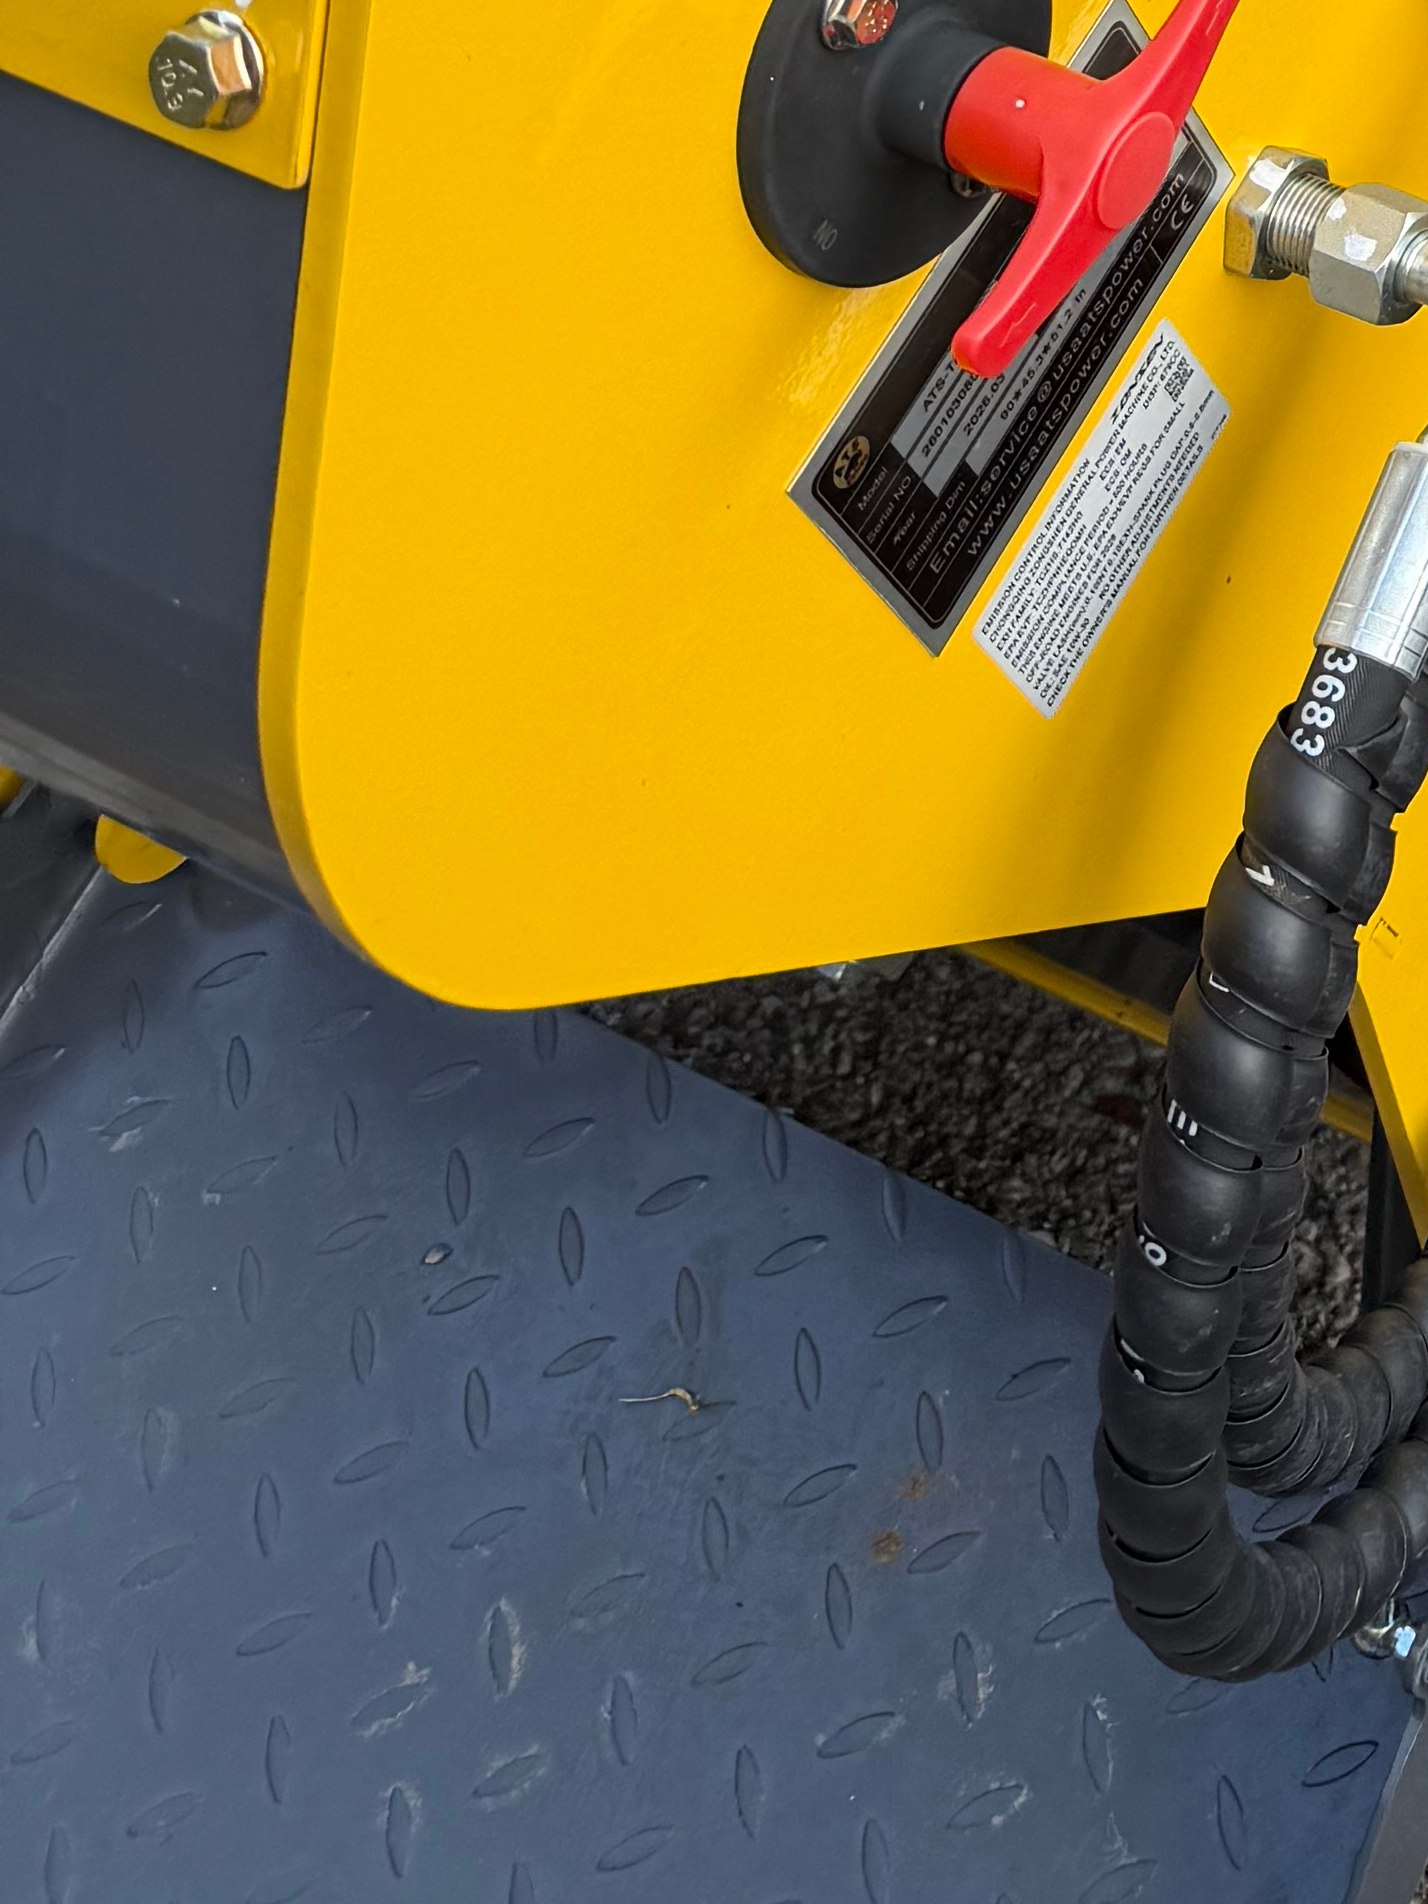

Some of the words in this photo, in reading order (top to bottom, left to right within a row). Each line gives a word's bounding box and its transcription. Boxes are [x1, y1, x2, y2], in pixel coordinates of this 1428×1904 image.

[856, 464, 889, 512] Model
[965, 275, 1145, 558] www.usaatspower.com
[865, 500, 896, 545] Serial
[893, 474, 912, 502] NO
[891, 508, 918, 547] Year
[905, 508, 948, 573] Shipping
[944, 478, 966, 511] Dim
[980, 580, 1016, 636] EMISSION
[1012, 528, 1047, 582] CONTROL
[1043, 457, 1090, 532] INFORMATION
[988, 575, 1032, 644] CHONGQING
[1028, 515, 1068, 577] ZONGSHEN
[1063, 467, 1096, 518] GENERAL
[1093, 427, 1120, 469] POWER
[1117, 380, 1149, 430] MACHINE
[1009, 613, 1045, 668] EMISSION
[1041, 544, 1086, 615] COMPLIANCE
[1082, 504, 1110, 547] PERIOD
[1122, 441, 1148, 480] HOURS
[1031, 656, 1055, 692] VALVE
[1152, 458, 1172, 489] PLUG
[1032, 607, 1061, 650] ENGINE
[1057, 570, 1083, 609] MEETS
[1131, 453, 1152, 485] REGS
[1149, 431, 1165, 456] FOR
[1162, 398, 1185, 433] SMALL
[1045, 668, 1071, 707] CHECK
[1068, 646, 1084, 669] THE
[1080, 597, 1113, 648] OWNER'S
[1109, 554, 1138, 599] MANUAL
[1134, 532, 1151, 557] FOR
[1147, 484, 1179, 534] FURTHER
[1175, 442, 1204, 487] DETAILS
[1098, 581, 1111, 601] NO
[1107, 544, 1132, 583] OTHER
[1128, 472, 1176, 548] ADJUSTMENTS
[1172, 430, 1201, 475] NEEDED
[1024, 626, 1061, 684] OFF-ROAD
[1057, 579, 1089, 629] ENGINES
[1086, 556, 1103, 582] FOR
[1051, 653, 1068, 678] SAE
